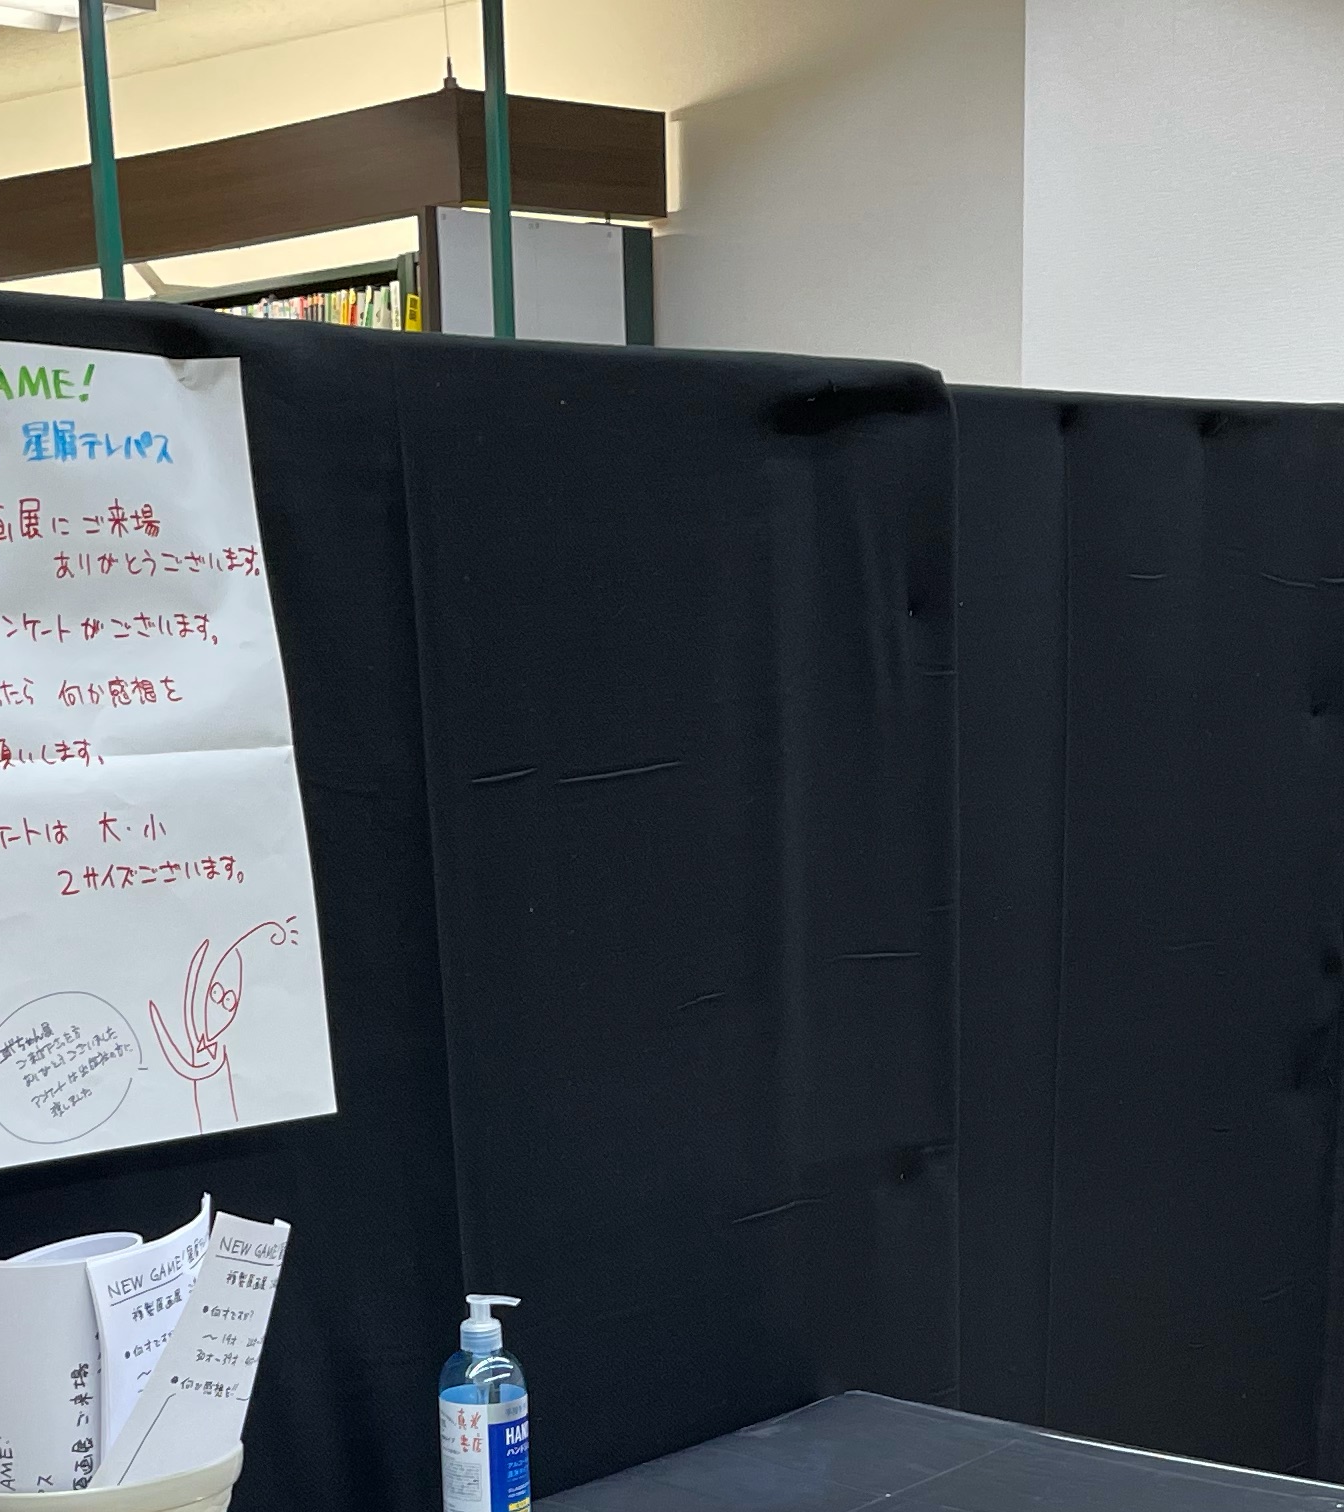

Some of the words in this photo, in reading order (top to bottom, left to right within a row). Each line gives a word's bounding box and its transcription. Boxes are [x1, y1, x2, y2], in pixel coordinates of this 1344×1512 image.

[57, 675, 183, 708] 何か感想を
[219, 1235, 252, 1256] NEW
[107, 1274, 144, 1299] NEW
